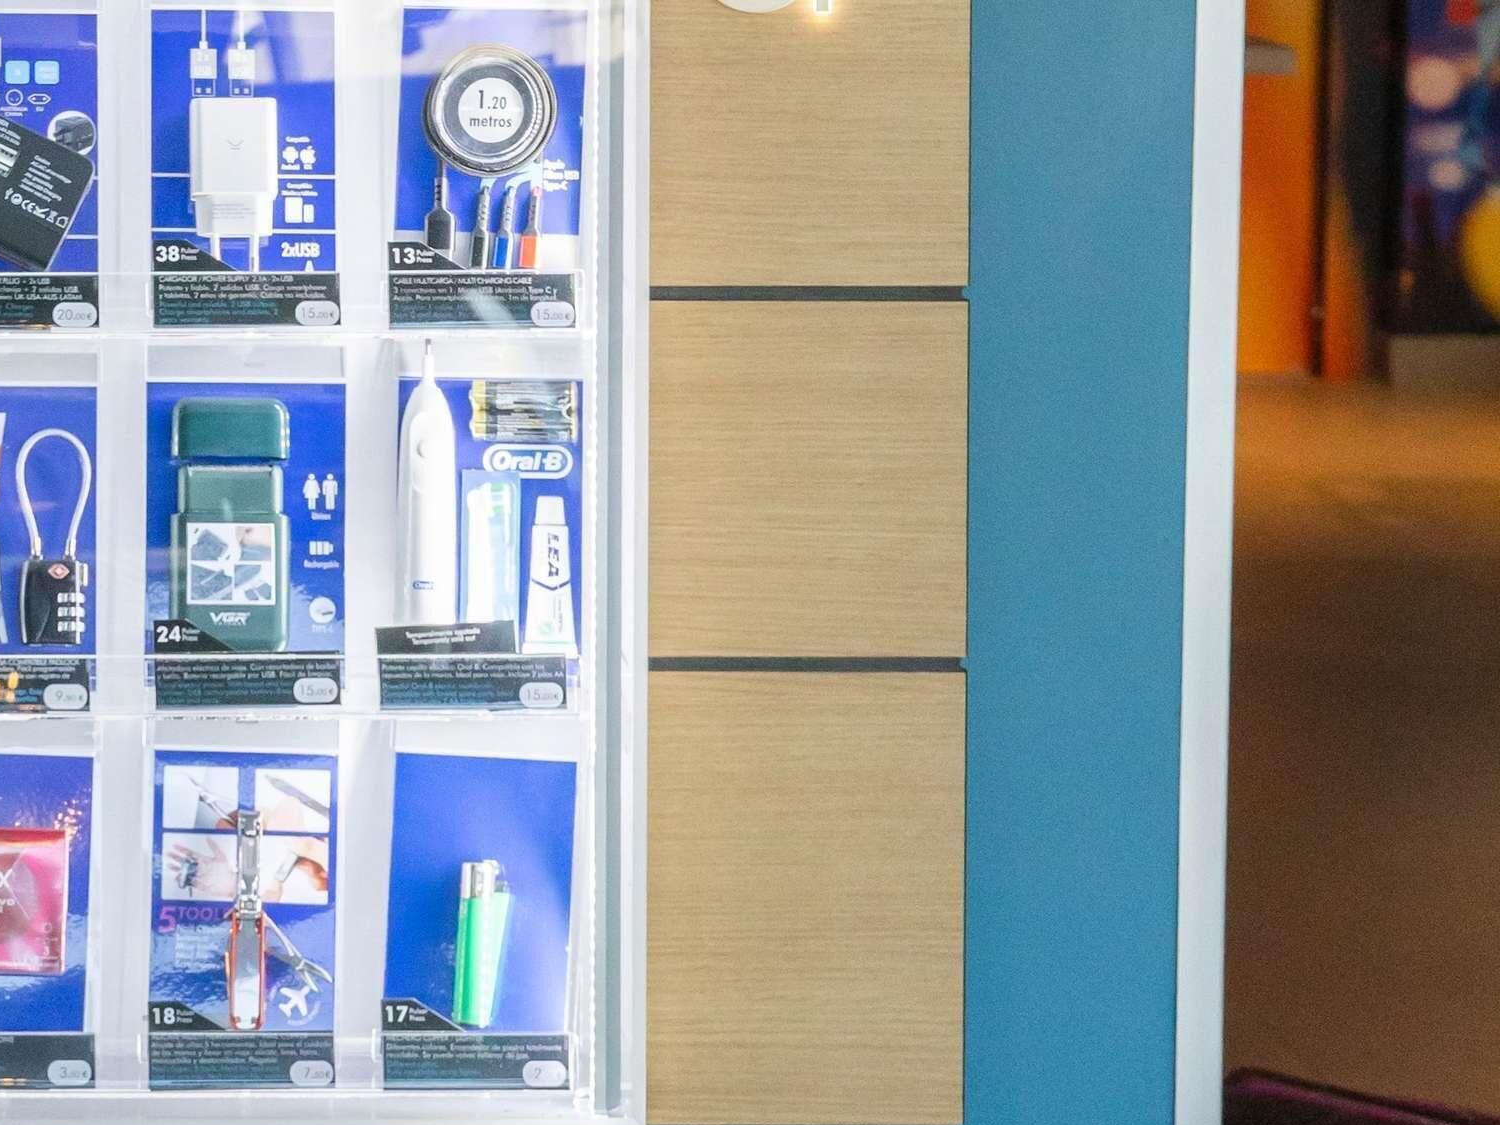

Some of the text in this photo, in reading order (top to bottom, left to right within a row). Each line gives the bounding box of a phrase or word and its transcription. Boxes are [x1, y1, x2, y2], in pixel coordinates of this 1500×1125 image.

[469, 117, 512, 127] metros
[155, 245, 180, 262] 38
[392, 247, 416, 264] 13
[492, 450, 564, 473] Oral-B
[156, 626, 181, 643] 24
[158, 907, 177, 934] 5
[152, 1007, 175, 1025] 18
[385, 1005, 408, 1022] 17
